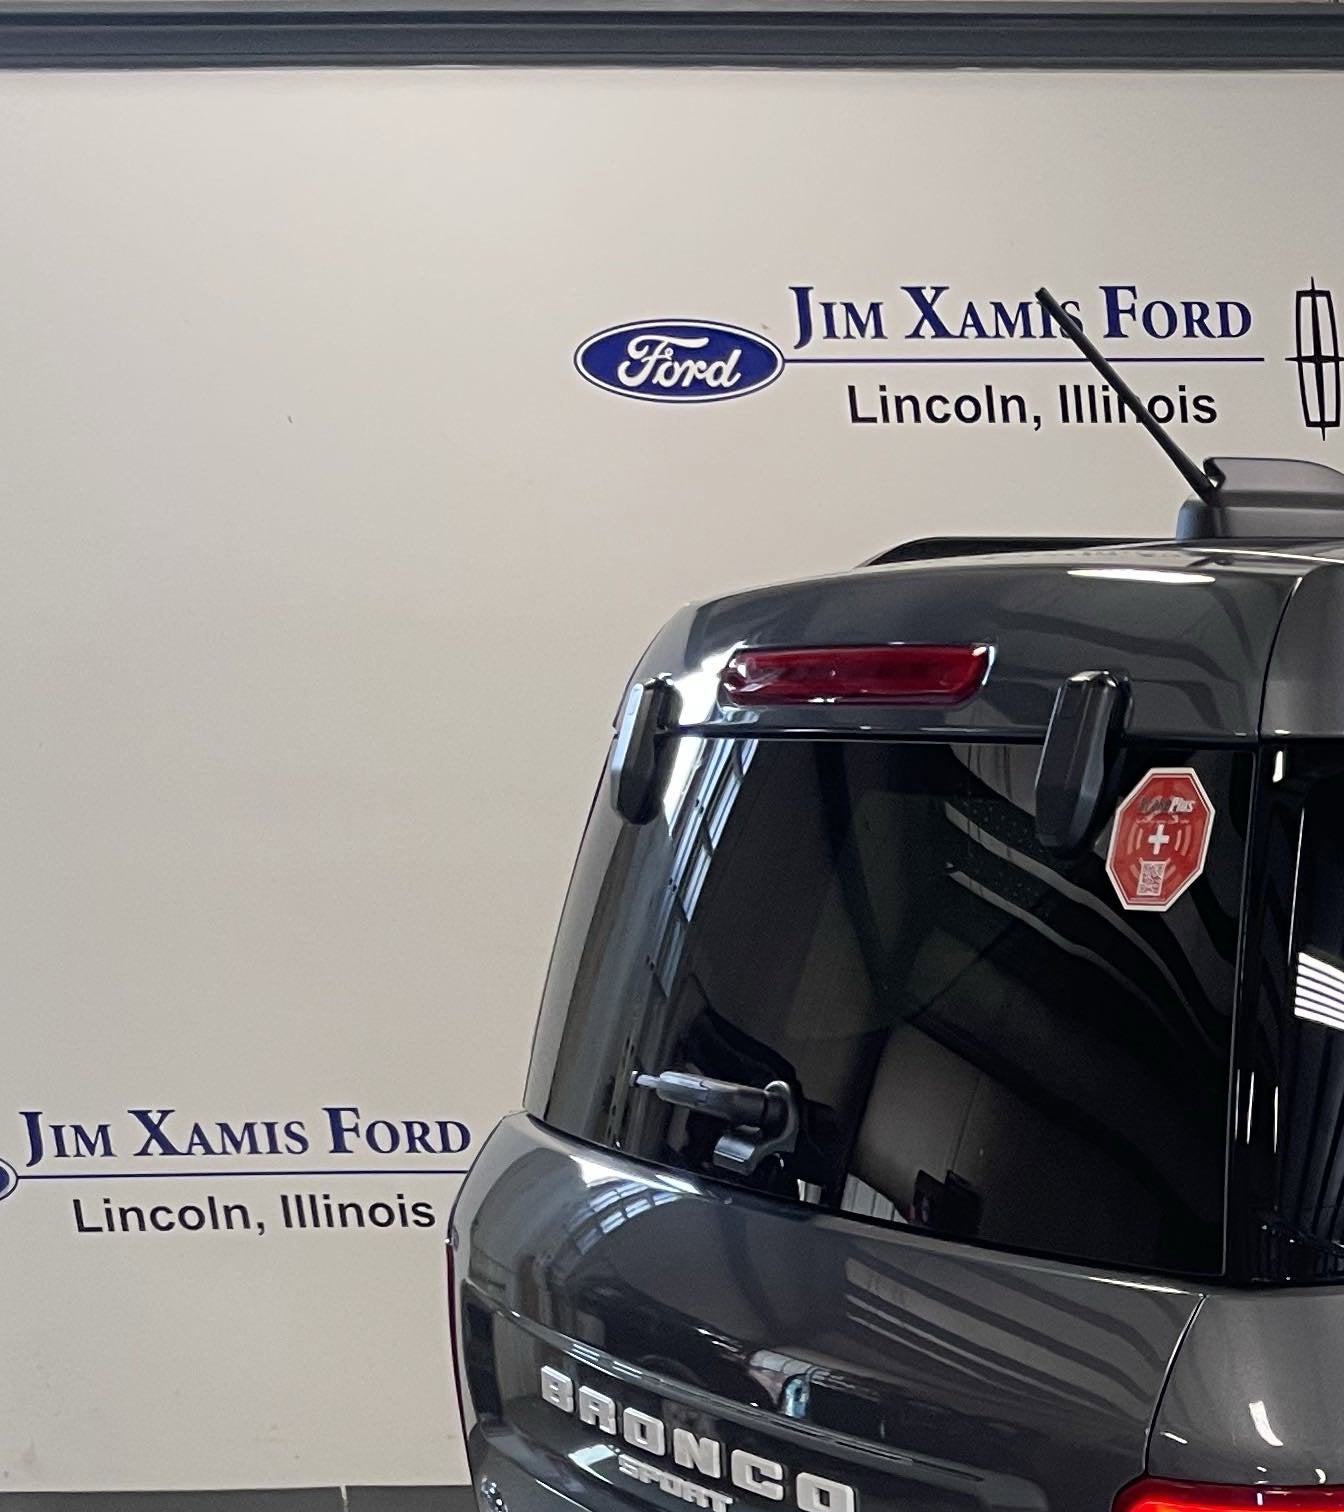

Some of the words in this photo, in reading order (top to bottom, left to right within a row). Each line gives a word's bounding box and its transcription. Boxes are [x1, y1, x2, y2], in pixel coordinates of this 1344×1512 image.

[788, 285, 889, 350] JIM
[900, 285, 1085, 340] XAMIS
[1099, 285, 1253, 340] FORD
[617, 334, 742, 387] Ford
[847, 384, 1042, 431] Lincoln,
[19, 1110, 118, 1167] JIM
[127, 1108, 310, 1157] XAMIS
[321, 1106, 472, 1155] FORD
[72, 1196, 267, 1236] Lincoln,
[280, 1193, 437, 1230] Illinois
